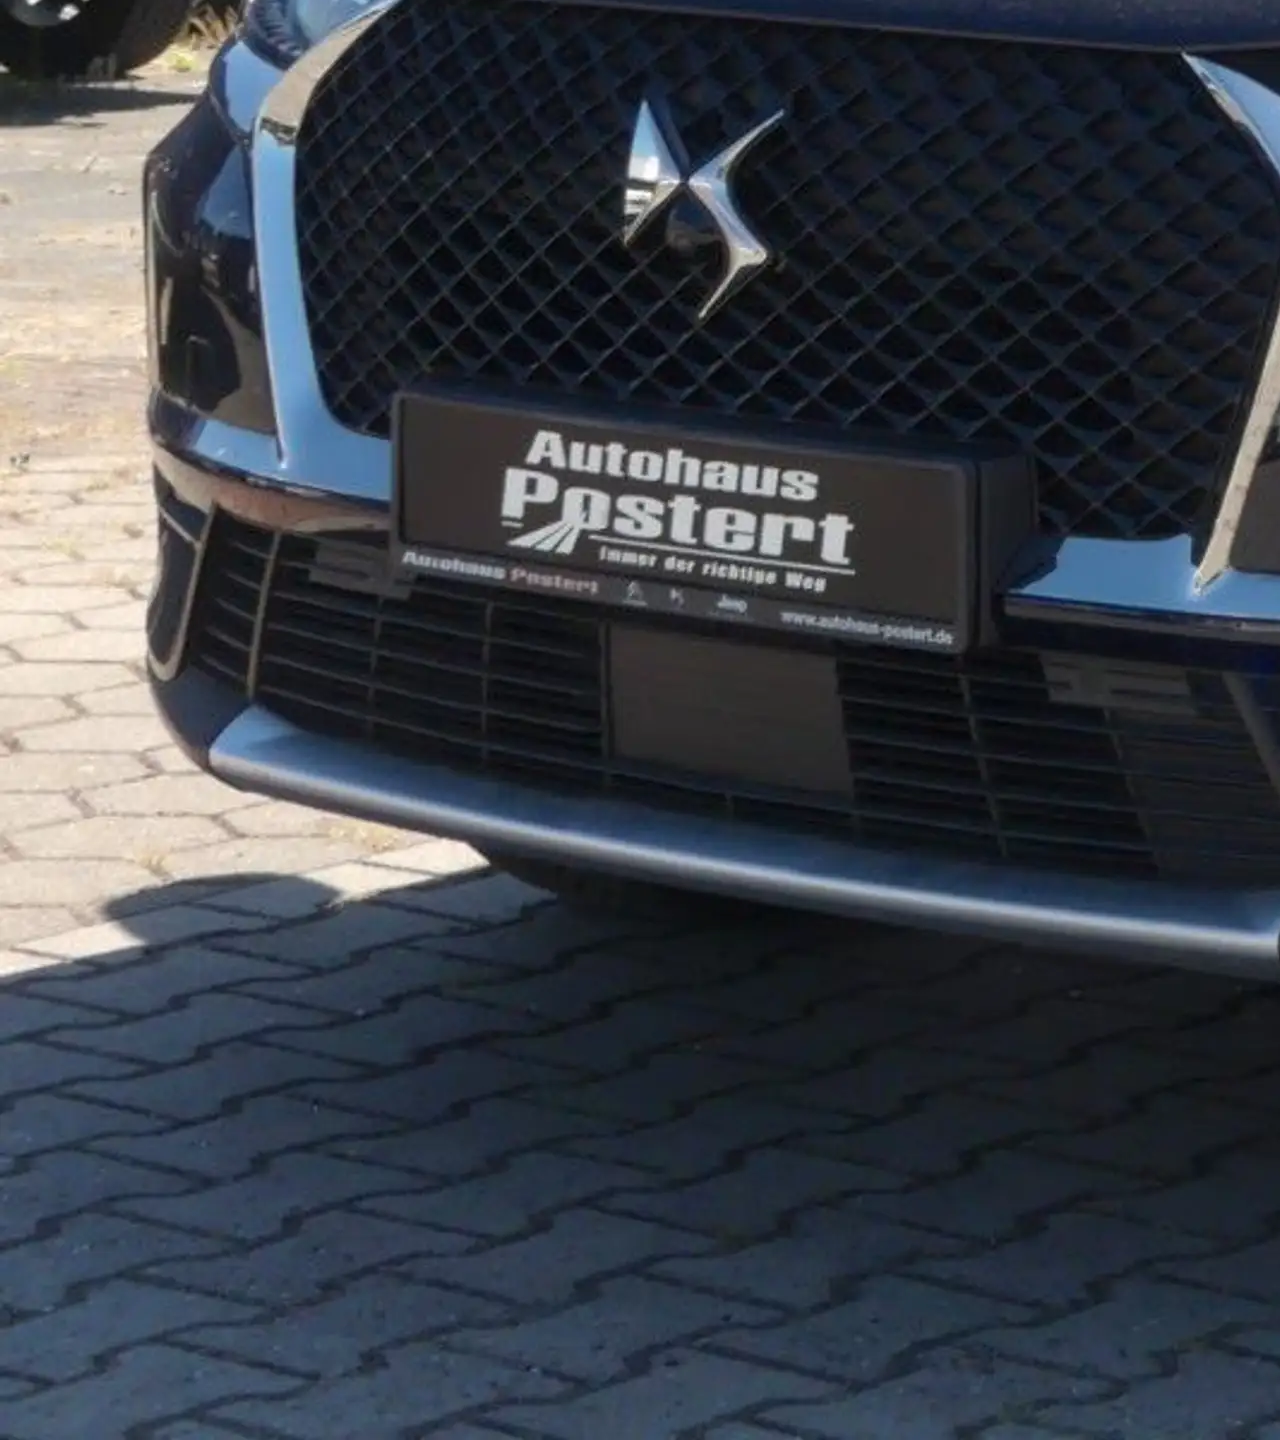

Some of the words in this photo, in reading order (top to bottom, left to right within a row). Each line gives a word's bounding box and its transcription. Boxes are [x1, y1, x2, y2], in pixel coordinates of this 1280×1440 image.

[526, 430, 820, 502] Autohaus
[501, 467, 855, 566] Postert
[402, 550, 507, 581] Autohaus
[509, 566, 599, 596] Postert
[600, 545, 658, 568] Immer
[663, 555, 697, 574] der
[701, 561, 778, 586] richtige
[785, 570, 828, 594] Weg
[780, 611, 955, 646] www.autohaus-postert.de
